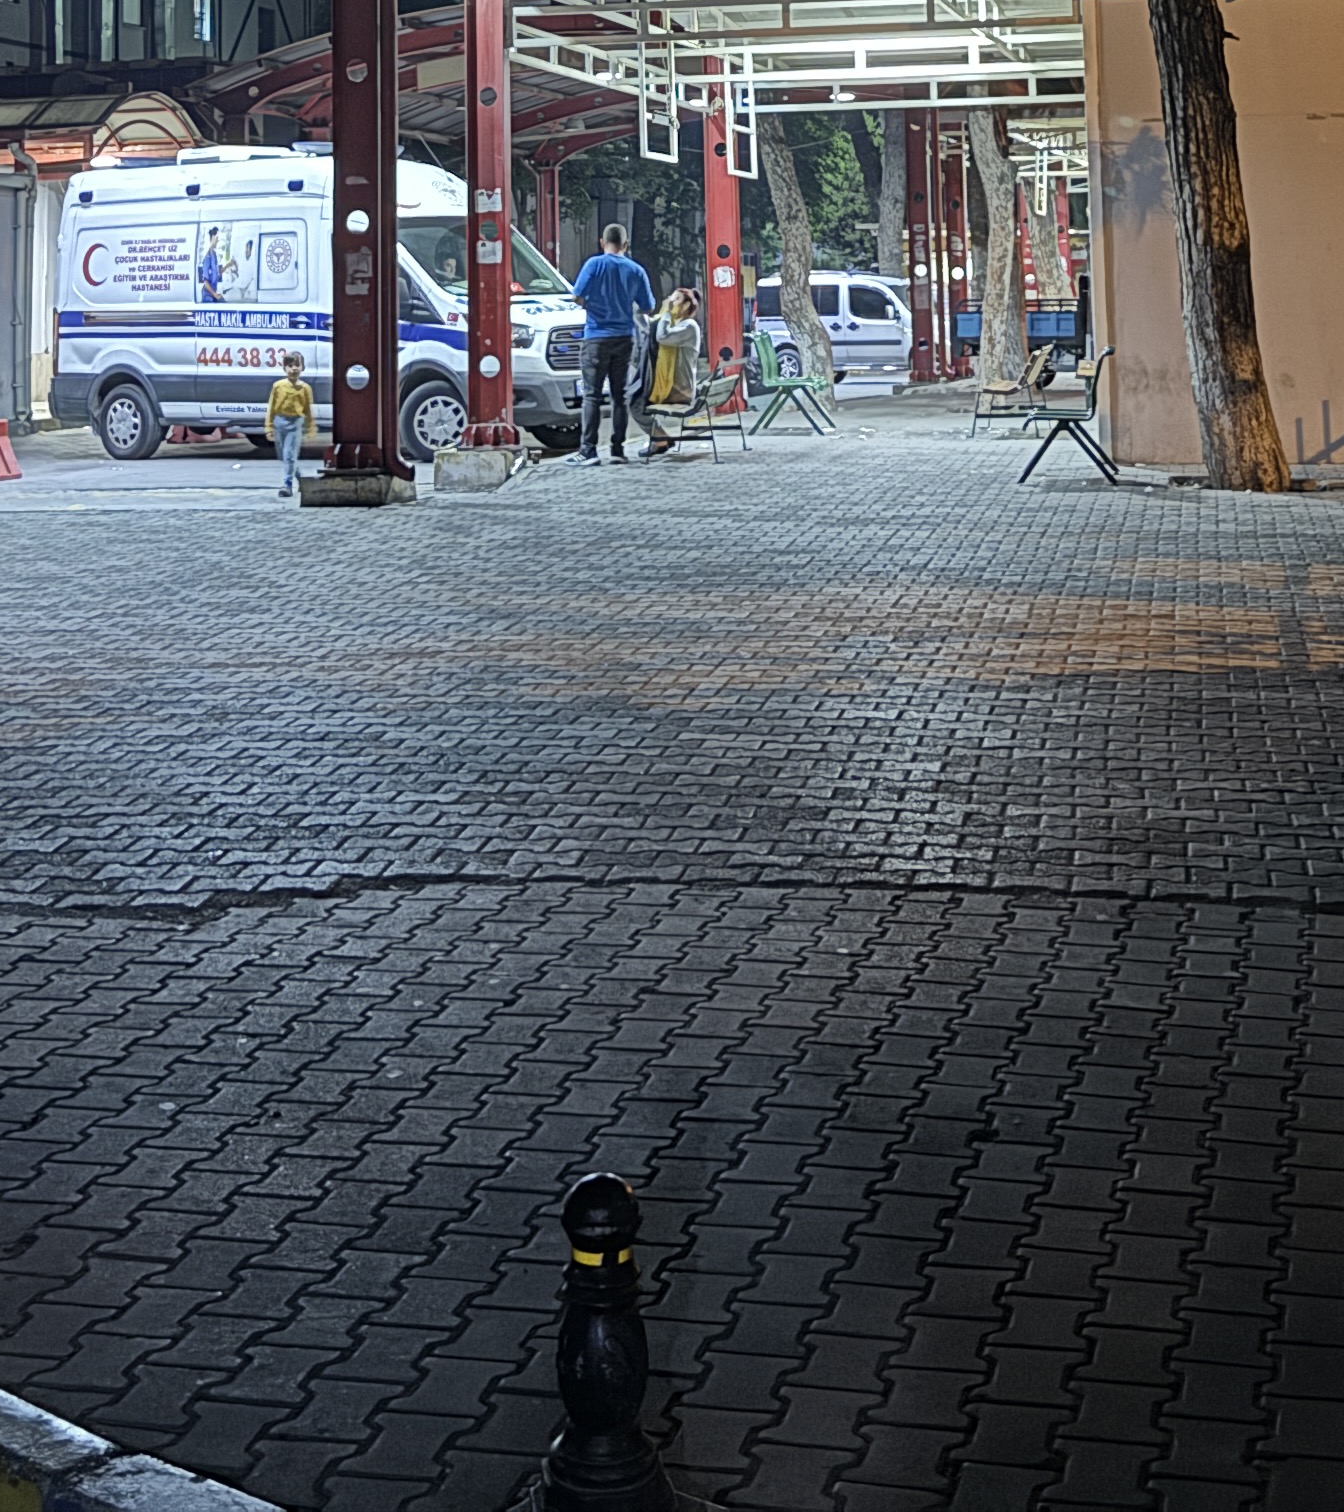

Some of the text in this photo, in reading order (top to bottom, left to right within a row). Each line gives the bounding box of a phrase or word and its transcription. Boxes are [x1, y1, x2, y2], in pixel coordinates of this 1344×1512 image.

[195, 311, 219, 327] HASTA
[245, 312, 290, 328] AMBULANSI
[197, 347, 233, 367] 444
[237, 347, 261, 367] 38
